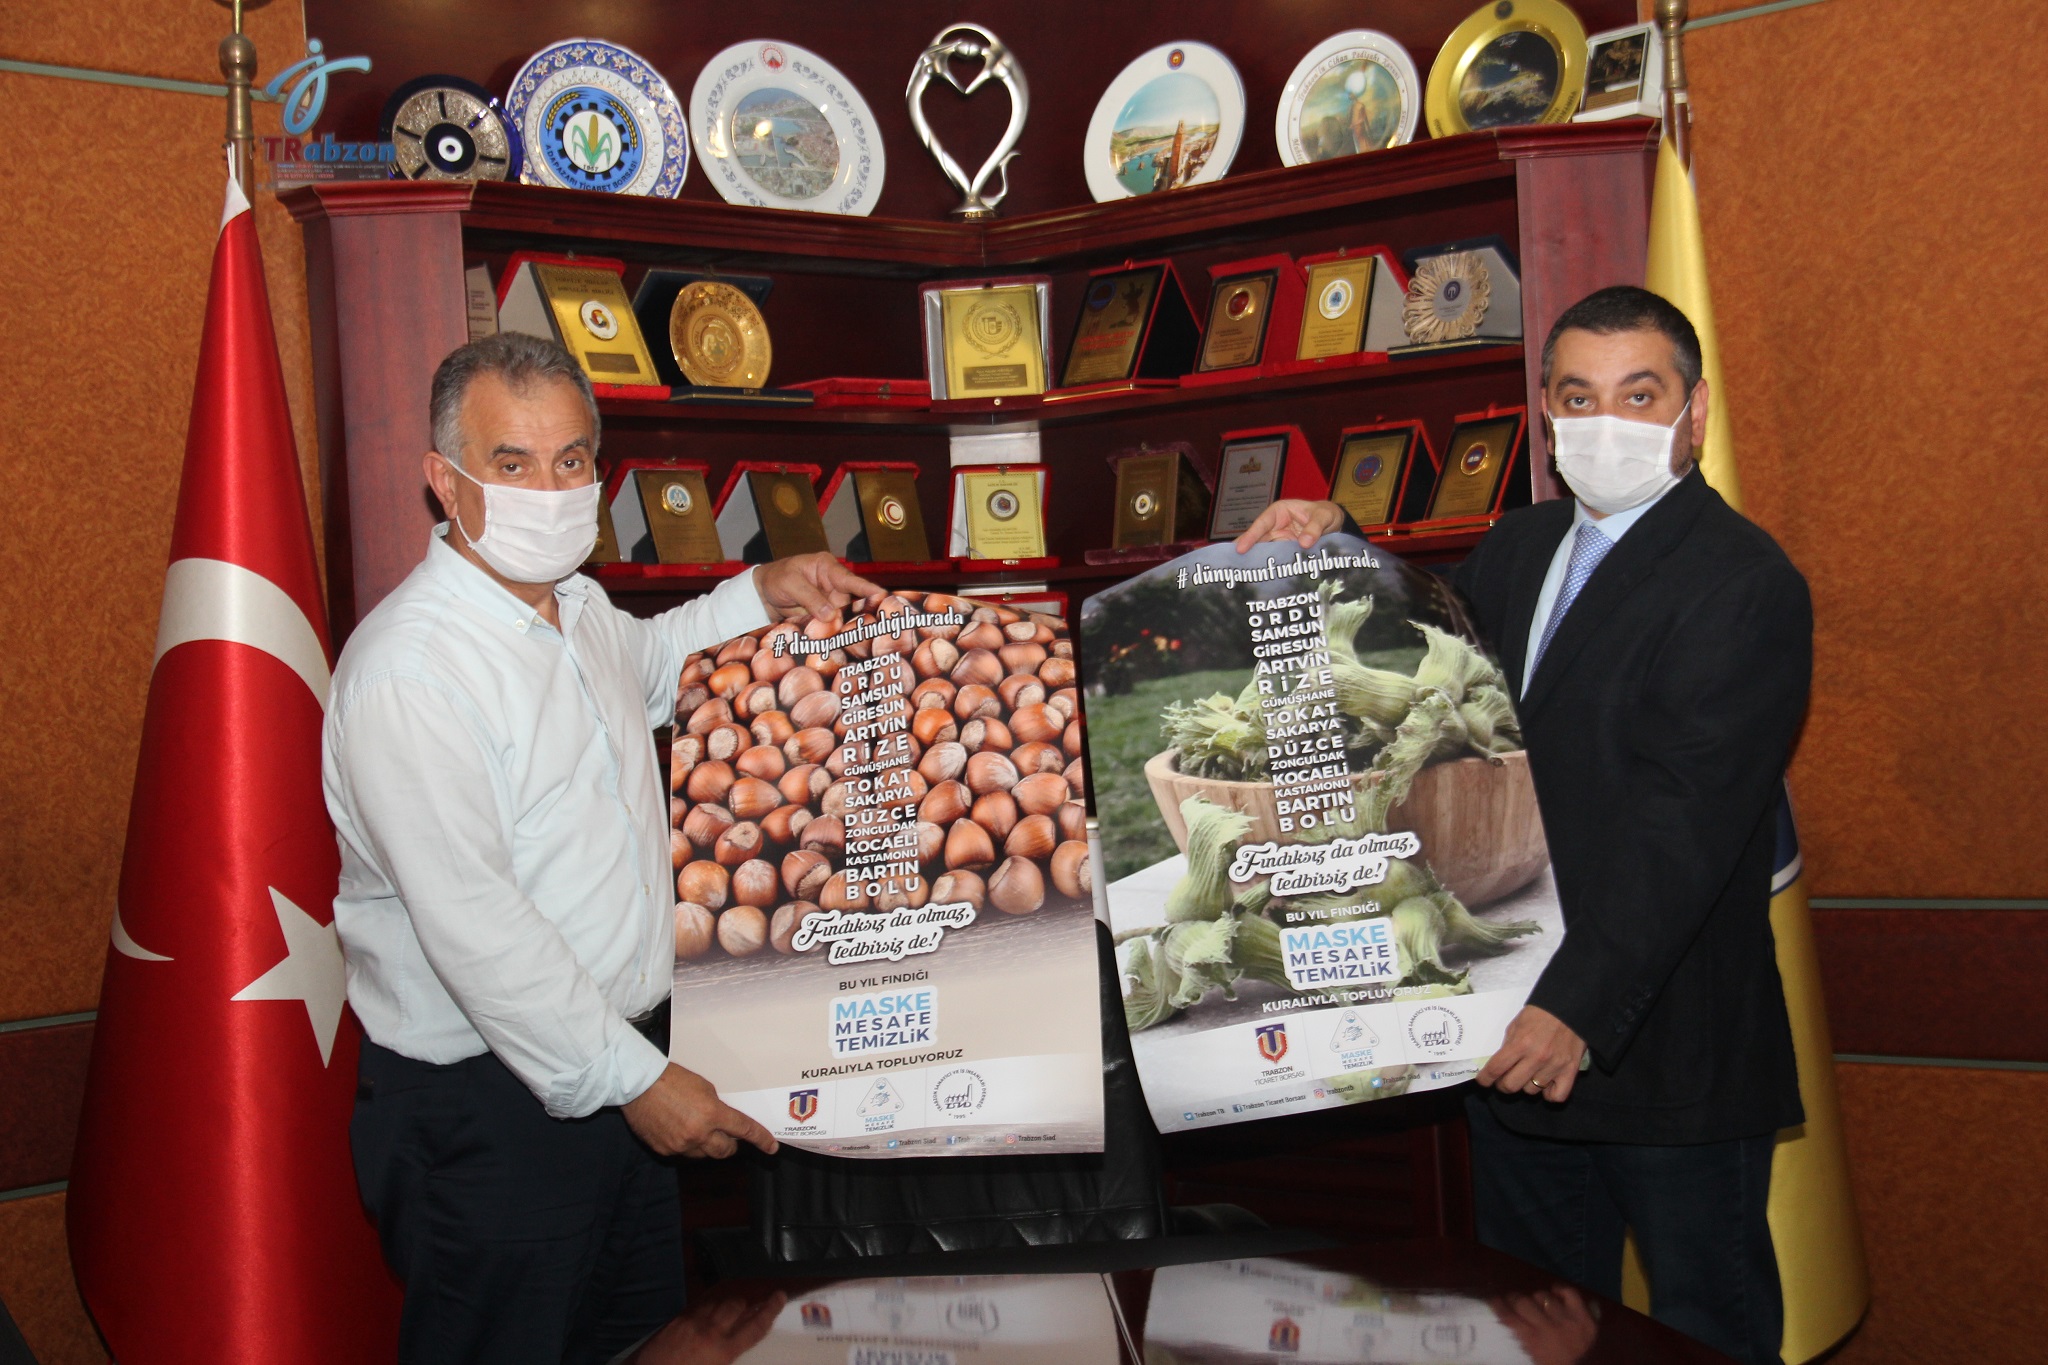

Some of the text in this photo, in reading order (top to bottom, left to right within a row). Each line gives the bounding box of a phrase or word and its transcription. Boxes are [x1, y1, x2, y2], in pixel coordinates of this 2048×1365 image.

[546, 144, 578, 186] ADAPAZARI
[612, 160, 638, 189] BORSASI
[1246, 592, 1319, 612] TRABZON
[1248, 605, 1322, 628] ORDU
[1251, 620, 1324, 643] SAMSUN
[839, 652, 900, 678] TRABZON
[840, 666, 901, 694] ORDU
[841, 682, 904, 710] SAMSUN
[1261, 689, 1335, 708] GÜMÜŞHANE
[1263, 702, 1337, 726] TOKAT
[1266, 718, 1340, 740] SAKARYA
[1268, 735, 1344, 759] DÜZCE
[844, 755, 910, 776] GÜMÜŞHANE
[1270, 750, 1345, 771] ZONGULDAK
[845, 769, 911, 794] TOKAT
[1274, 779, 1350, 799] KASTAMONU
[845, 786, 913, 808] SAKARYA
[1276, 790, 1354, 815] BARTIN
[845, 804, 916, 827] DÜZCE
[1279, 807, 1356, 833] BOLU
[846, 820, 916, 839] ZONGULDAK
[846, 849, 918, 867] KASTAMONU
[1234, 837, 1414, 877] Fındıksız da olmaz,
[846, 860, 919, 883] BARTIN
[1276, 862, 1383, 891] tedbirsiz de!
[846, 877, 919, 901] BOLU
[1285, 901, 1381, 923] BU YIL FINDIĞI
[797, 906, 970, 946] Fındıksız da olmaz,
[834, 931, 938, 960] tedbirsiz de!
[1286, 924, 1388, 952] MASKE
[1290, 945, 1391, 967] MESAFE
[839, 969, 929, 991] BU YIL FINDIĞI
[835, 991, 931, 1021] MASKE
[1262, 985, 1432, 1013] KURALIYLA TOPLUYORUZ
[835, 1011, 931, 1036] MESAFE
[801, 1048, 963, 1080] KURALIYLA TOPLUYORUZ
[1341, 1049, 1373, 1060] MASKE
[1261, 1065, 1293, 1077] TRABZON
[1195, 1109, 1217, 1118] Trabzon
[1242, 1101, 1264, 1110] Trabzon
[1265, 1098, 1284, 1107] Ticaret
[865, 1114, 895, 1123] MASKE
[899, 1138, 921, 1146] Trabzon
